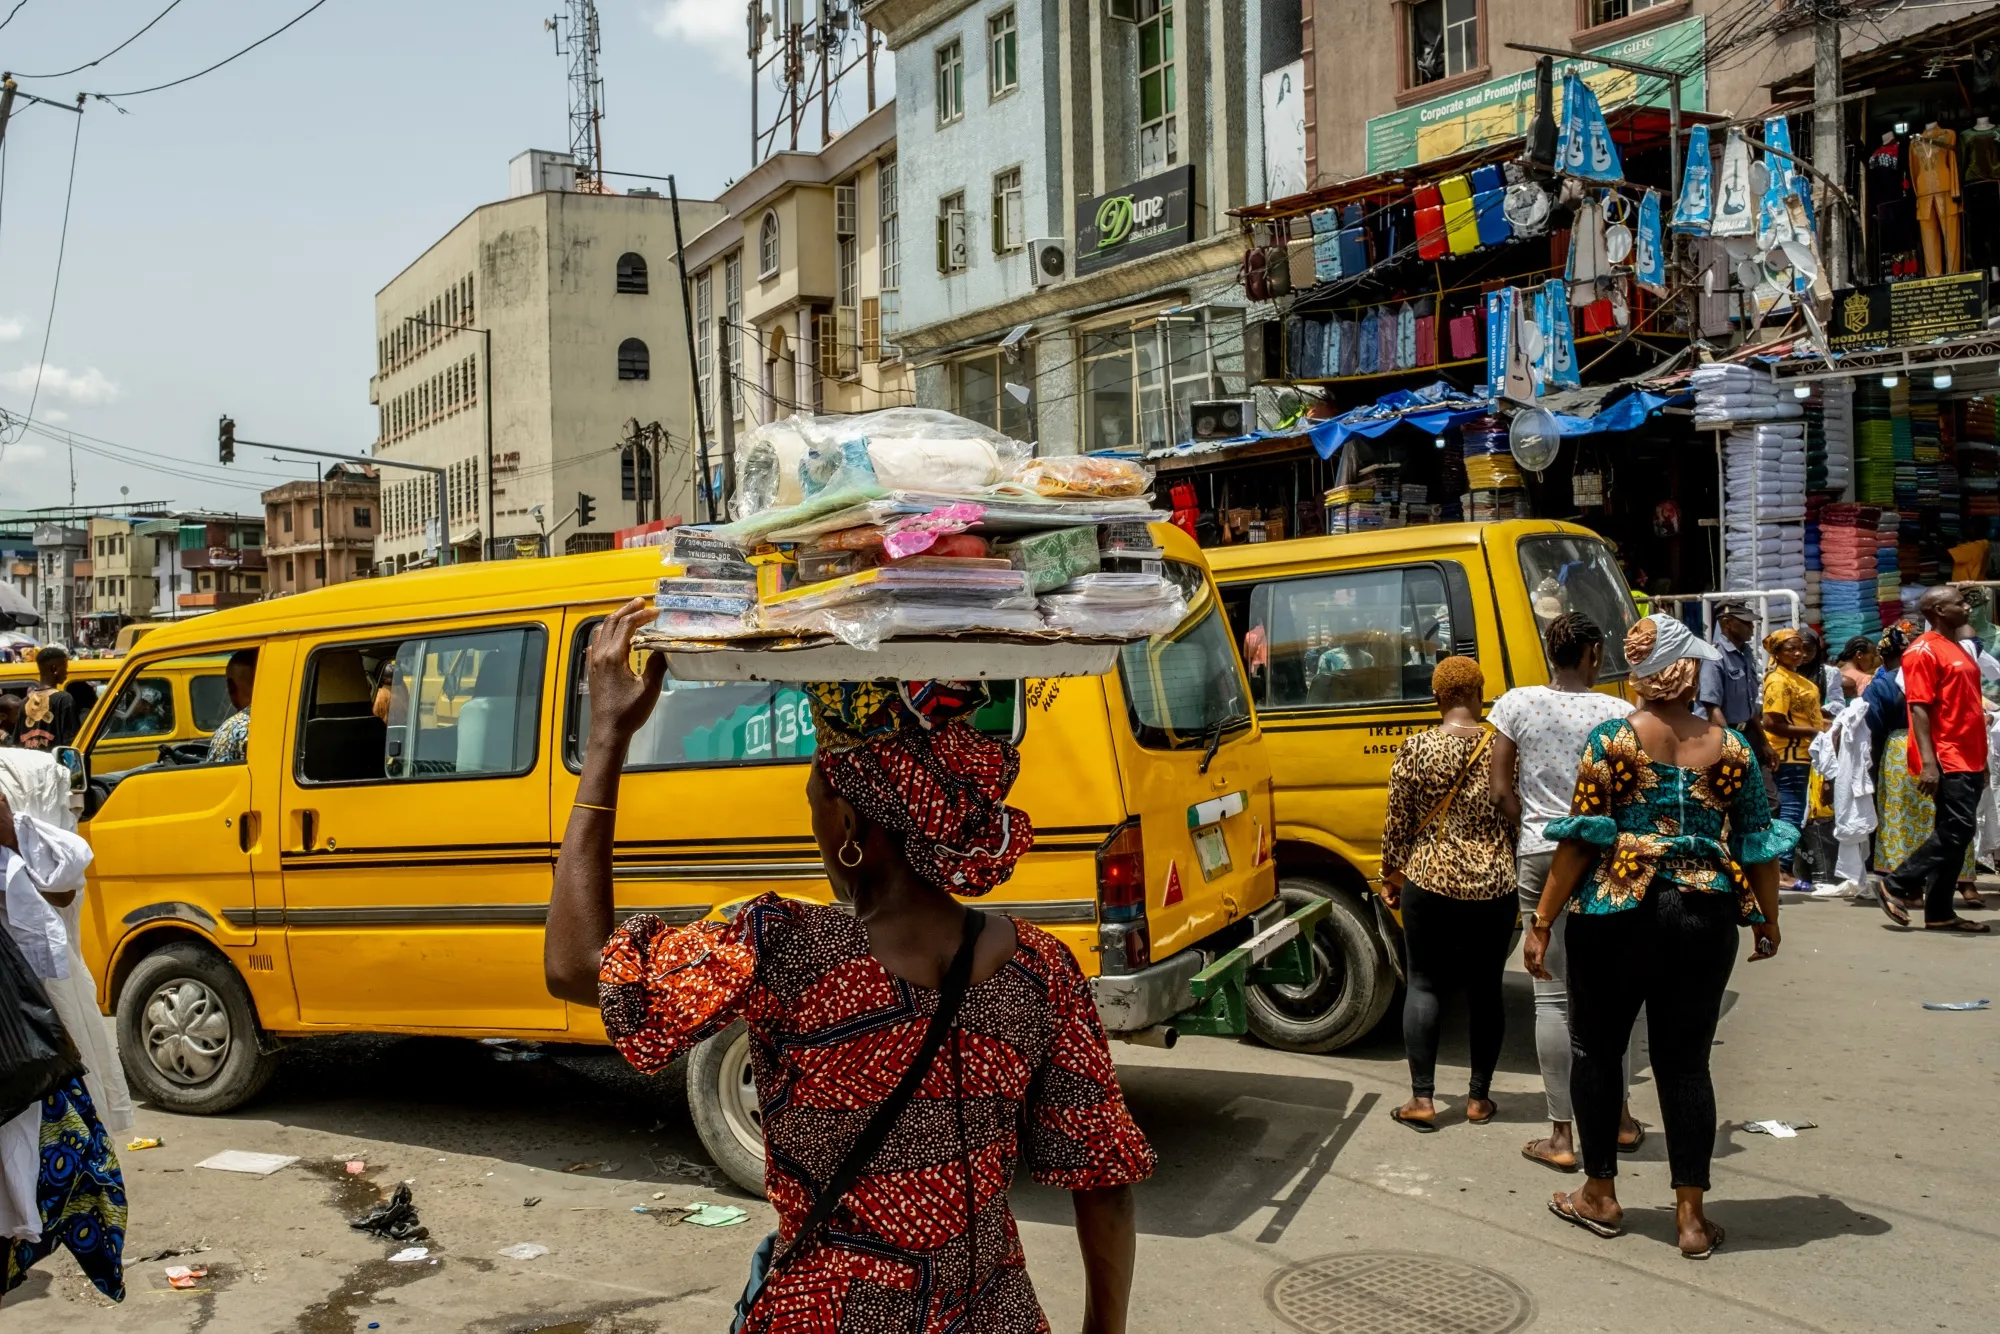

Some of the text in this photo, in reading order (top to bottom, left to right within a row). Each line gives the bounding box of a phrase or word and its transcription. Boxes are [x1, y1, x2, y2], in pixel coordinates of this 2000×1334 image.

[1420, 99, 1464, 122] Corporate
[1465, 92, 1482, 108] and
[1484, 78, 1536, 101] Promotiona
[1552, 65, 1562, 82] ift
[1157, 222, 1167, 232] SPA
[1830, 330, 1889, 345] MODULES
[703, 540, 732, 549] ORIGINAL
